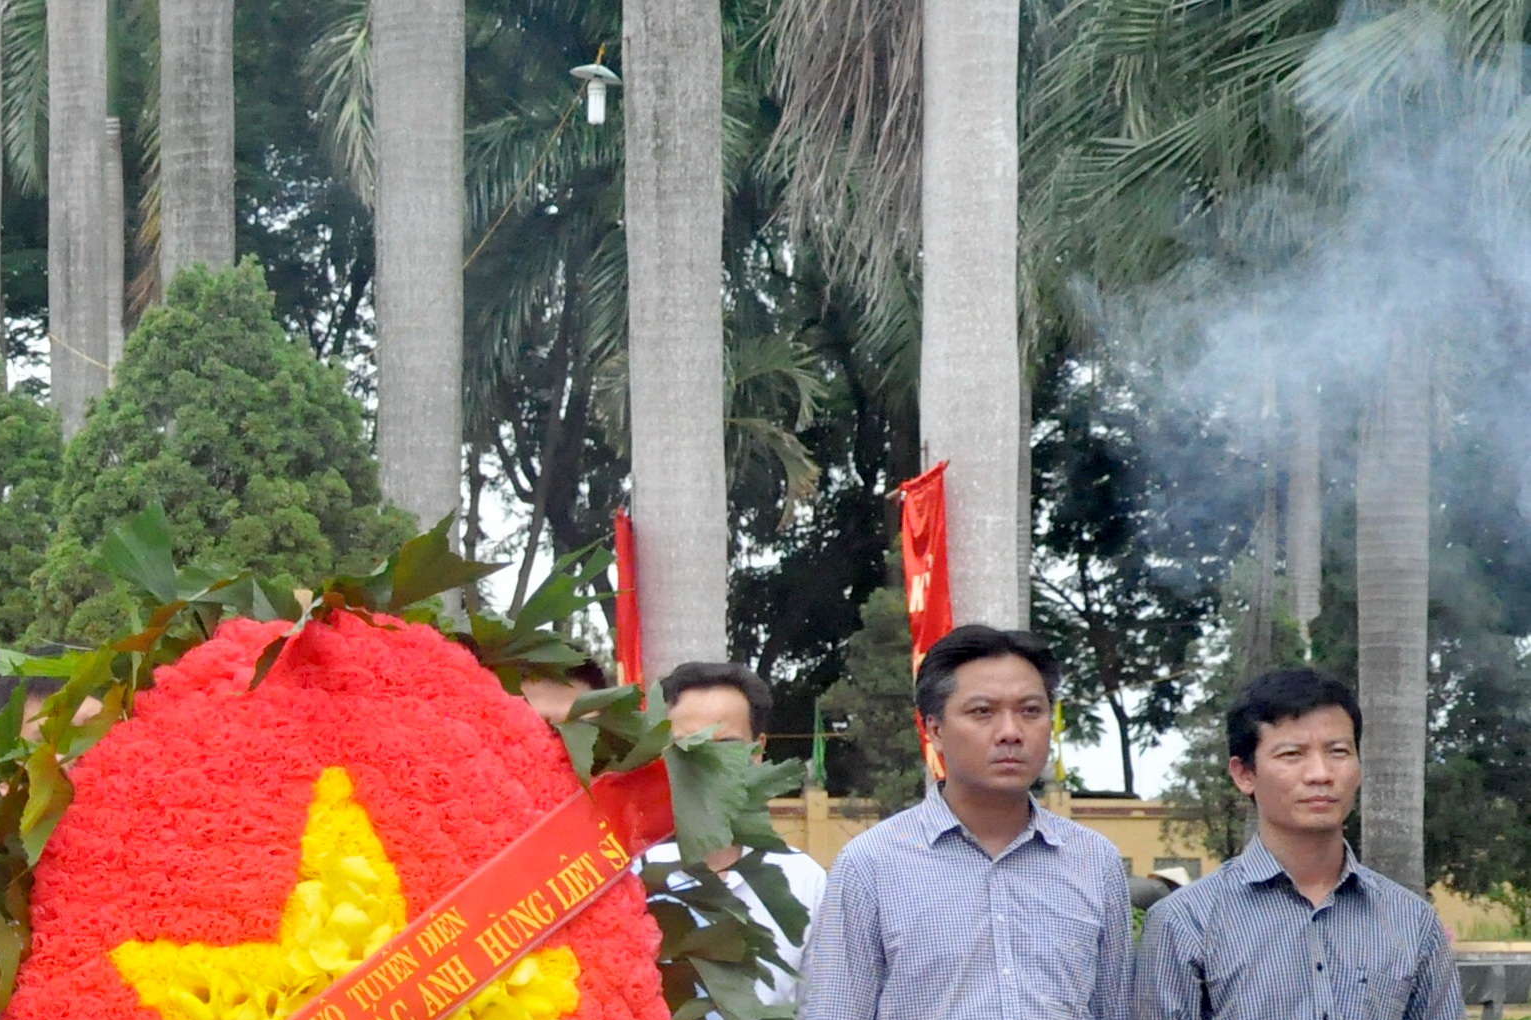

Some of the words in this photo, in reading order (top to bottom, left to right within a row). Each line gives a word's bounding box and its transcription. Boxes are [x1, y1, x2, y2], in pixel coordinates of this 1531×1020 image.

[345, 944, 420, 1011] TUYẾN
[415, 906, 468, 958] ĐIỆN
[417, 954, 477, 1018] ANH
[474, 889, 557, 967] HÙNG
[545, 852, 606, 911] LIỆT
[598, 820, 631, 871] SĨ
